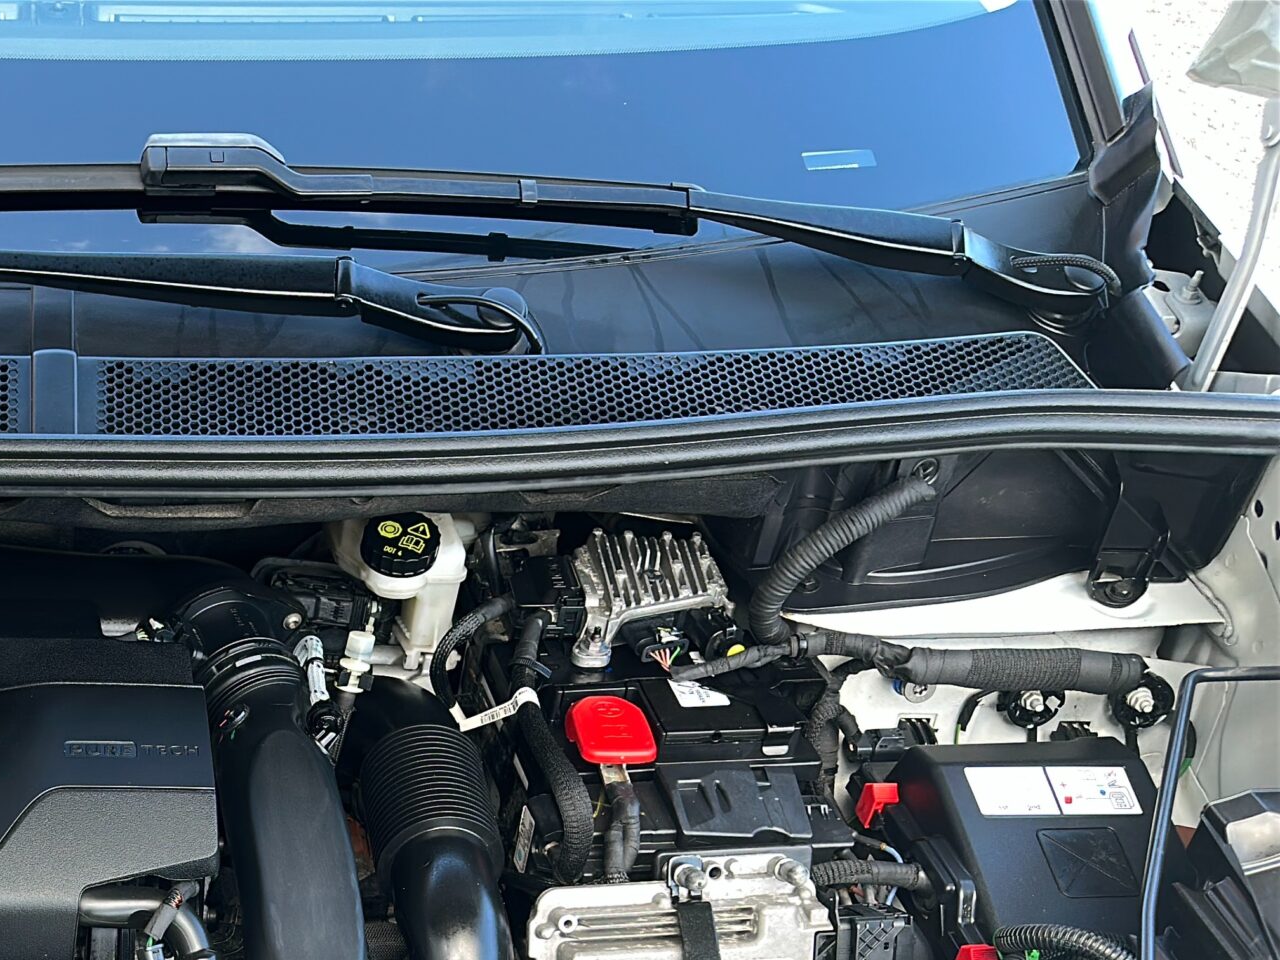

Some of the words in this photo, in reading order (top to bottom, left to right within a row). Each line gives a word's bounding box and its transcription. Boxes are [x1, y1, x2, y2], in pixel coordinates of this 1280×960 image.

[383, 545, 397, 554] DOT
[69, 743, 135, 757] PURE
[140, 744, 200, 757] TECH
